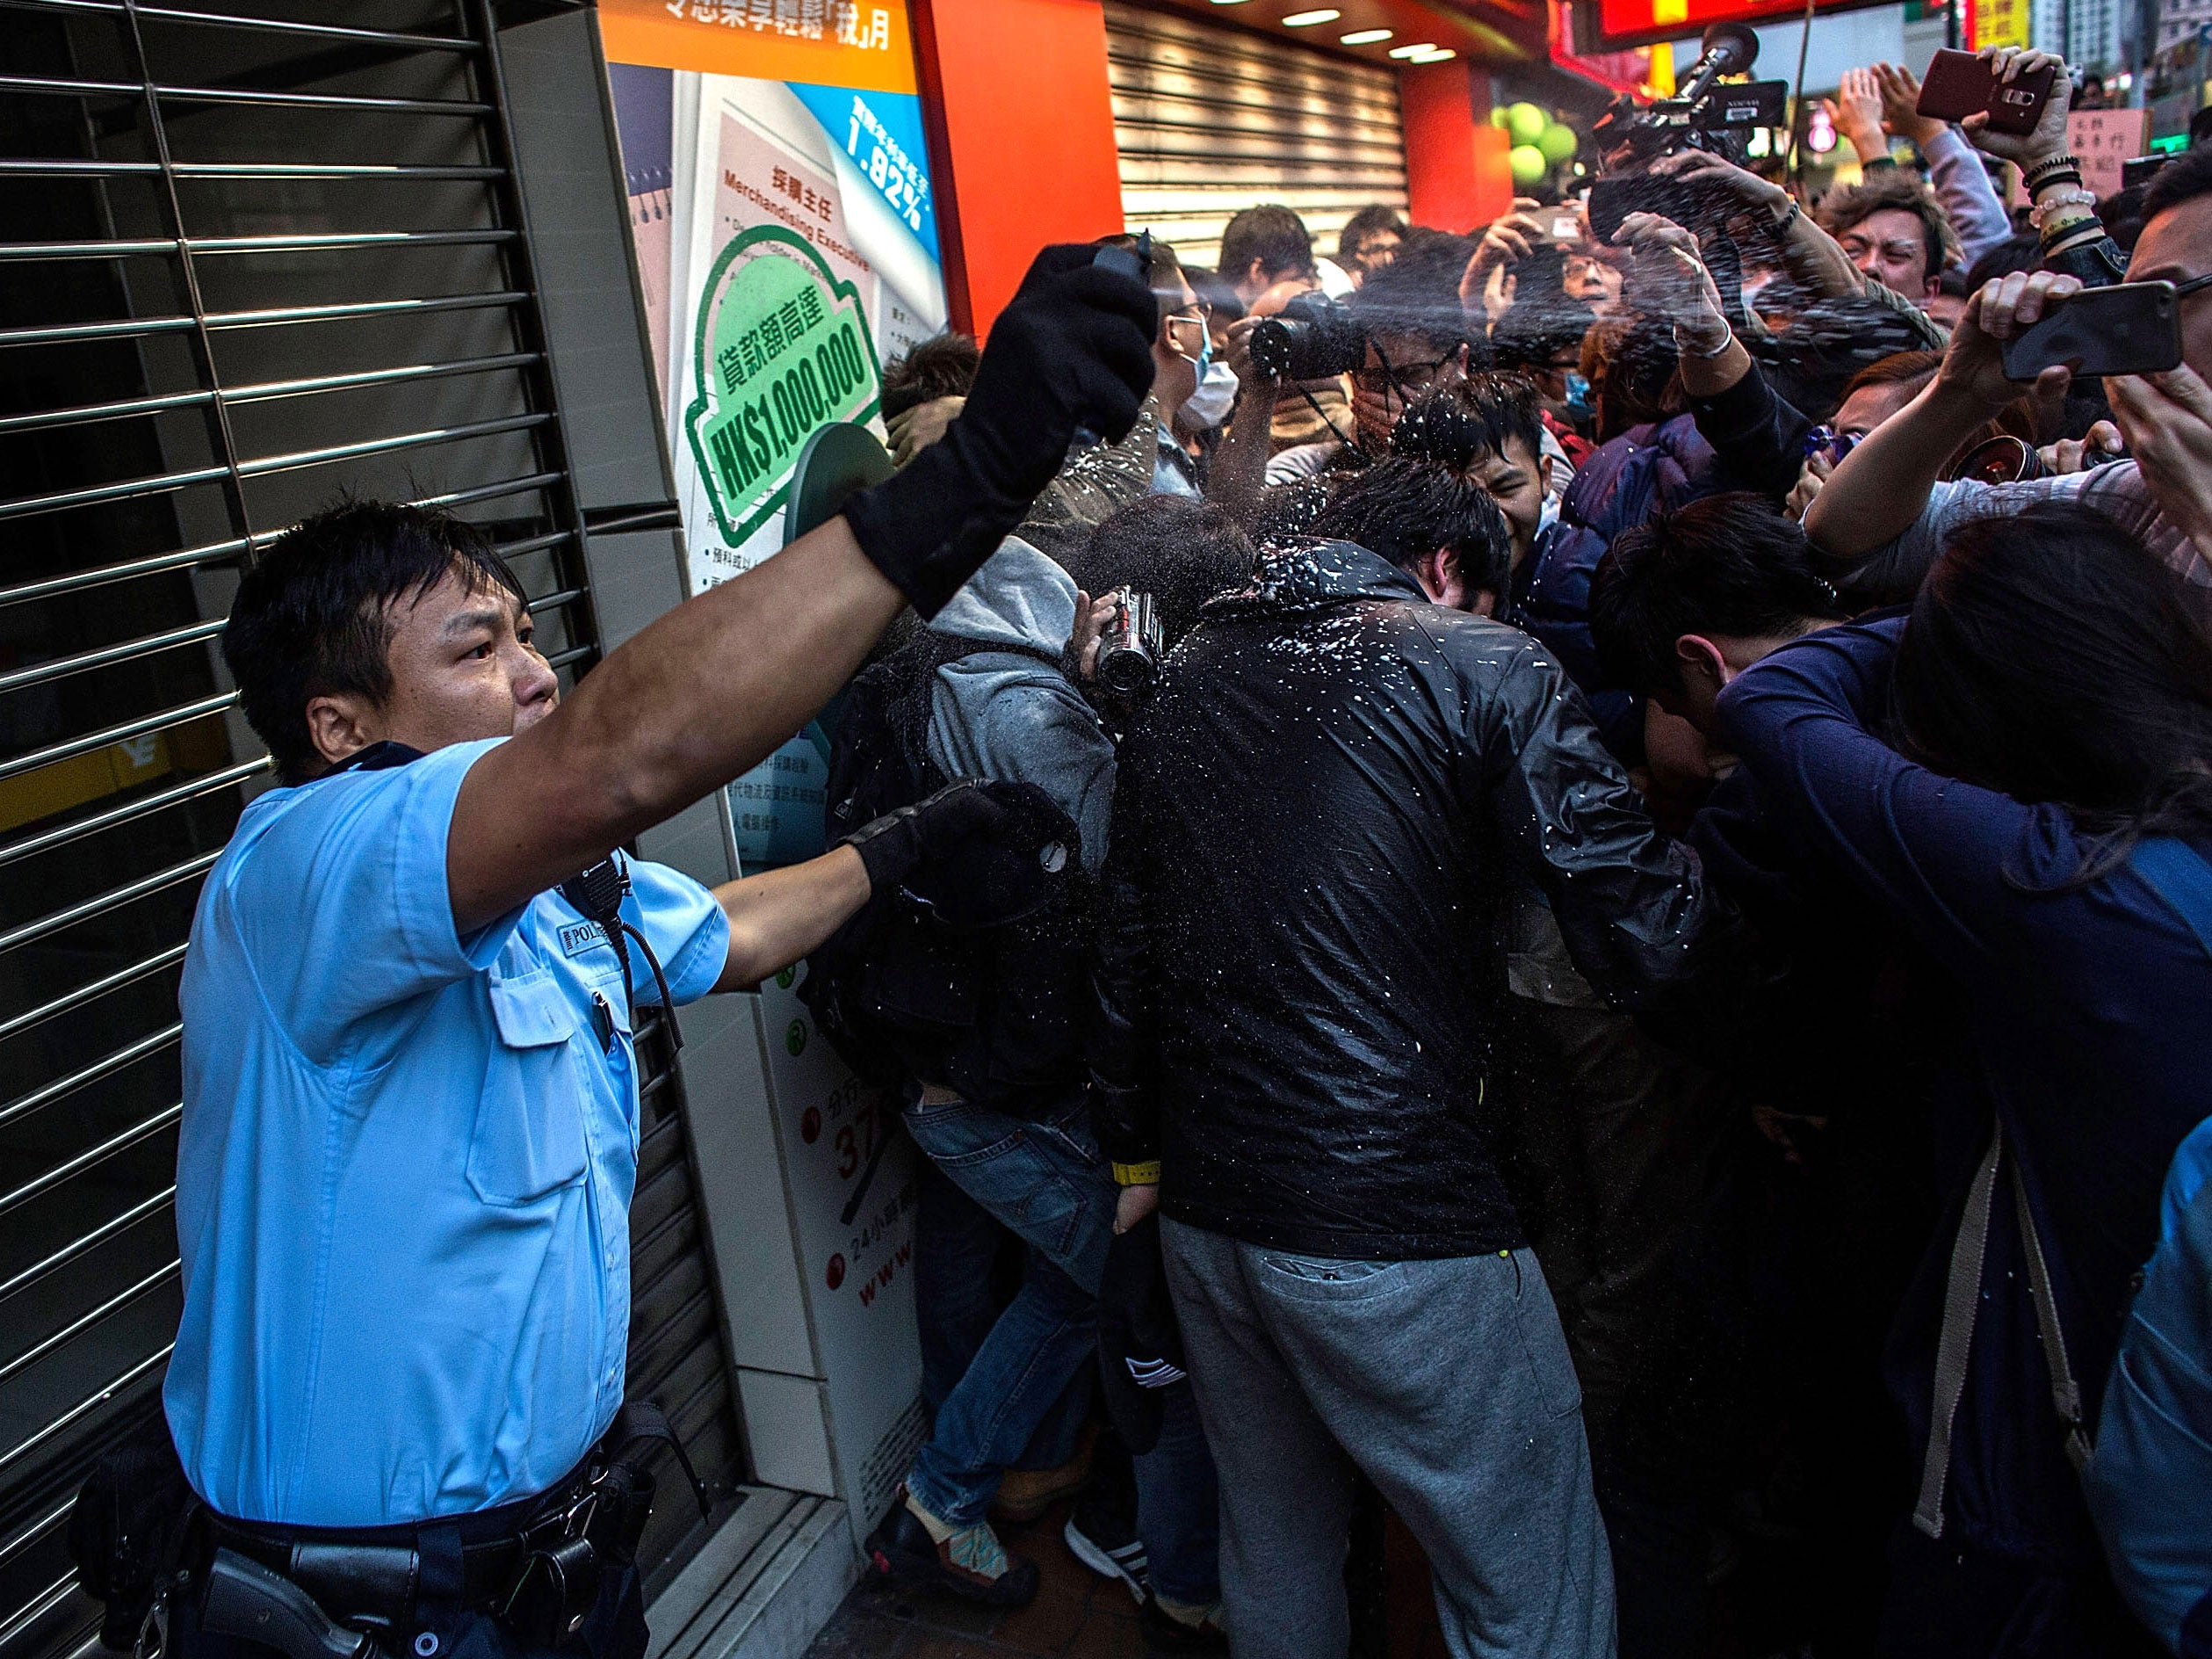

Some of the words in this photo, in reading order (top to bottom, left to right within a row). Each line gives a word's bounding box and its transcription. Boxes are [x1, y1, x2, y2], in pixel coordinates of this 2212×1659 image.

[725, 169, 813, 242] Merchandising
[817, 228, 871, 272] Executive
[710, 322, 864, 500] HK$1,000,000
